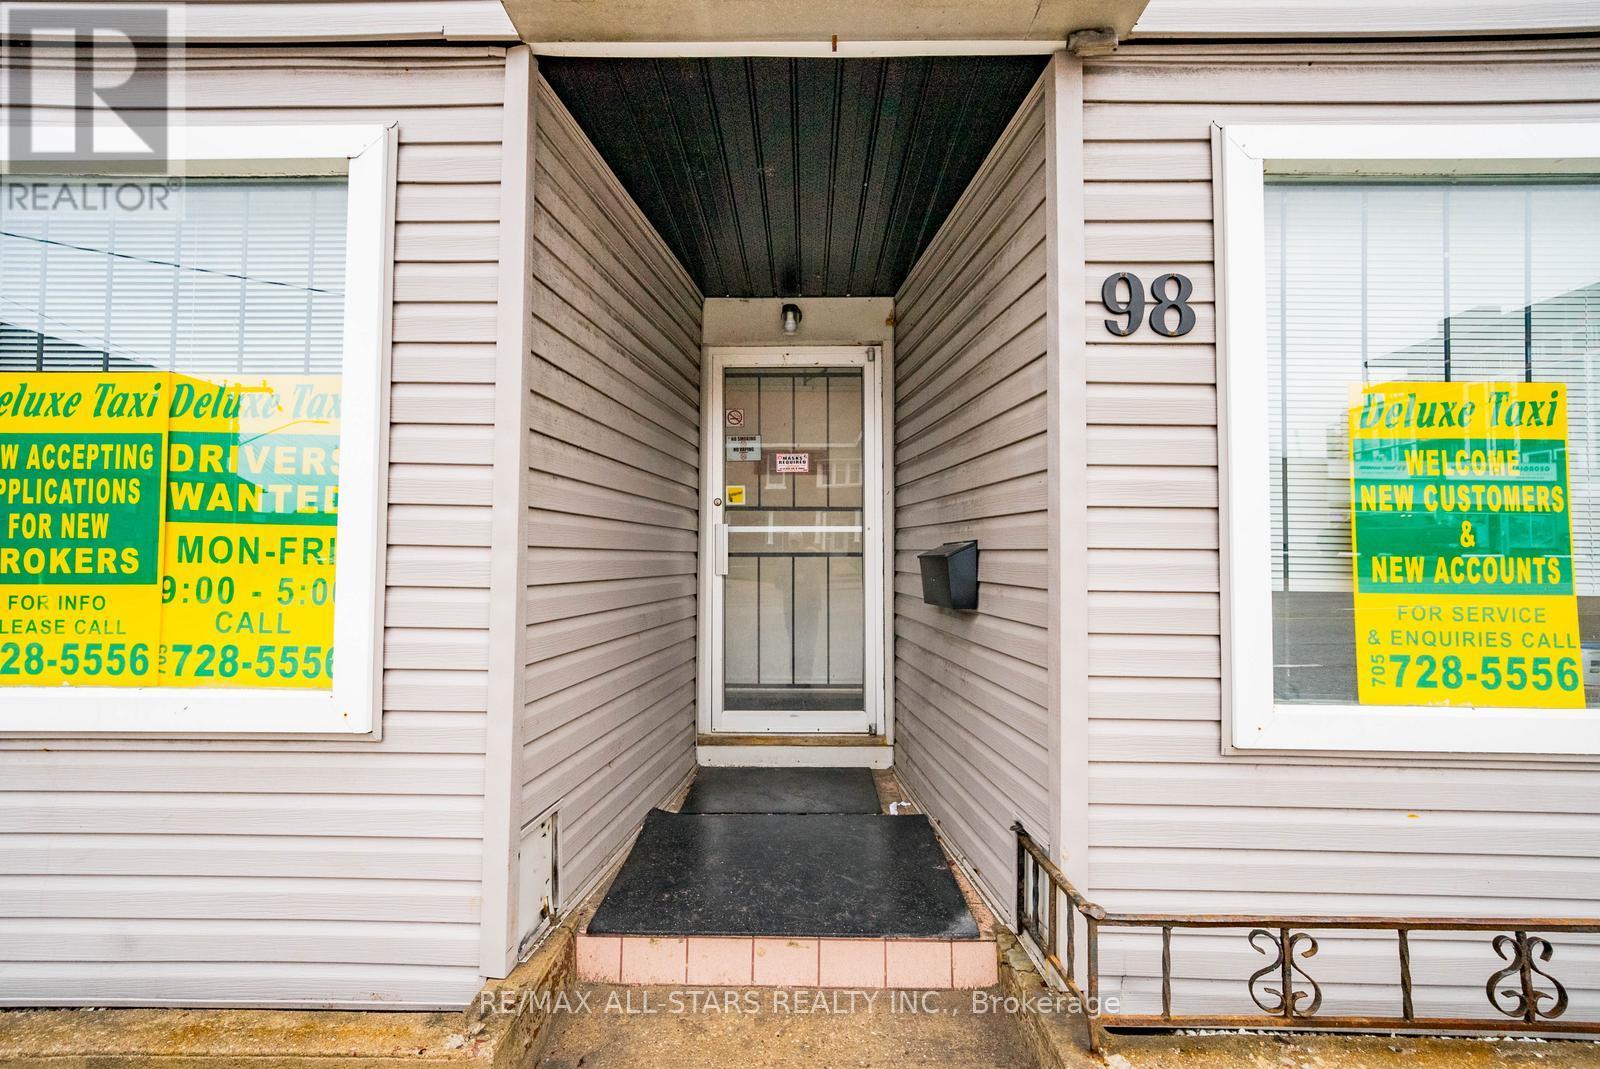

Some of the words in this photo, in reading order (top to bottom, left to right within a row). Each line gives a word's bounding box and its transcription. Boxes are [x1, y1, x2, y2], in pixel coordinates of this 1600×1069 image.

[1101, 271, 1196, 337] 98
[94, 382, 162, 418] Taxi
[169, 383, 281, 419] Deluxe
[1359, 392, 1476, 429] Deluxe
[1488, 390, 1559, 428] Taxi
[25, 444, 154, 470] ACCEPTING
[1404, 449, 1521, 477] WELCOME
[1360, 485, 1414, 511] NEW
[1423, 485, 1565, 513] CUSTOMERS
[8, 512, 52, 539] FOR
[61, 512, 110, 539] NEW
[1460, 520, 1476, 548] &
[177, 535, 335, 565] MON-FRI
[1371, 556, 1425, 583] NEW
[1434, 556, 1561, 584] ACCOUNTS
[8, 594, 49, 611] FOR
[58, 594, 106, 611] INFO
[161, 575, 235, 604] 9:00
[277, 577, 336, 606] 5:0
[74, 619, 127, 635] CALL
[215, 611, 291, 634] CALL
[1397, 605, 1443, 622] FOR
[1452, 606, 1547, 623] SERVICE
[1367, 630, 1382, 645] &
[1390, 630, 1513, 649] ENQUIRIES
[1521, 631, 1577, 649] CALL
[1370, 653, 1385, 687] 705
[1389, 654, 1580, 692] 728-5556
